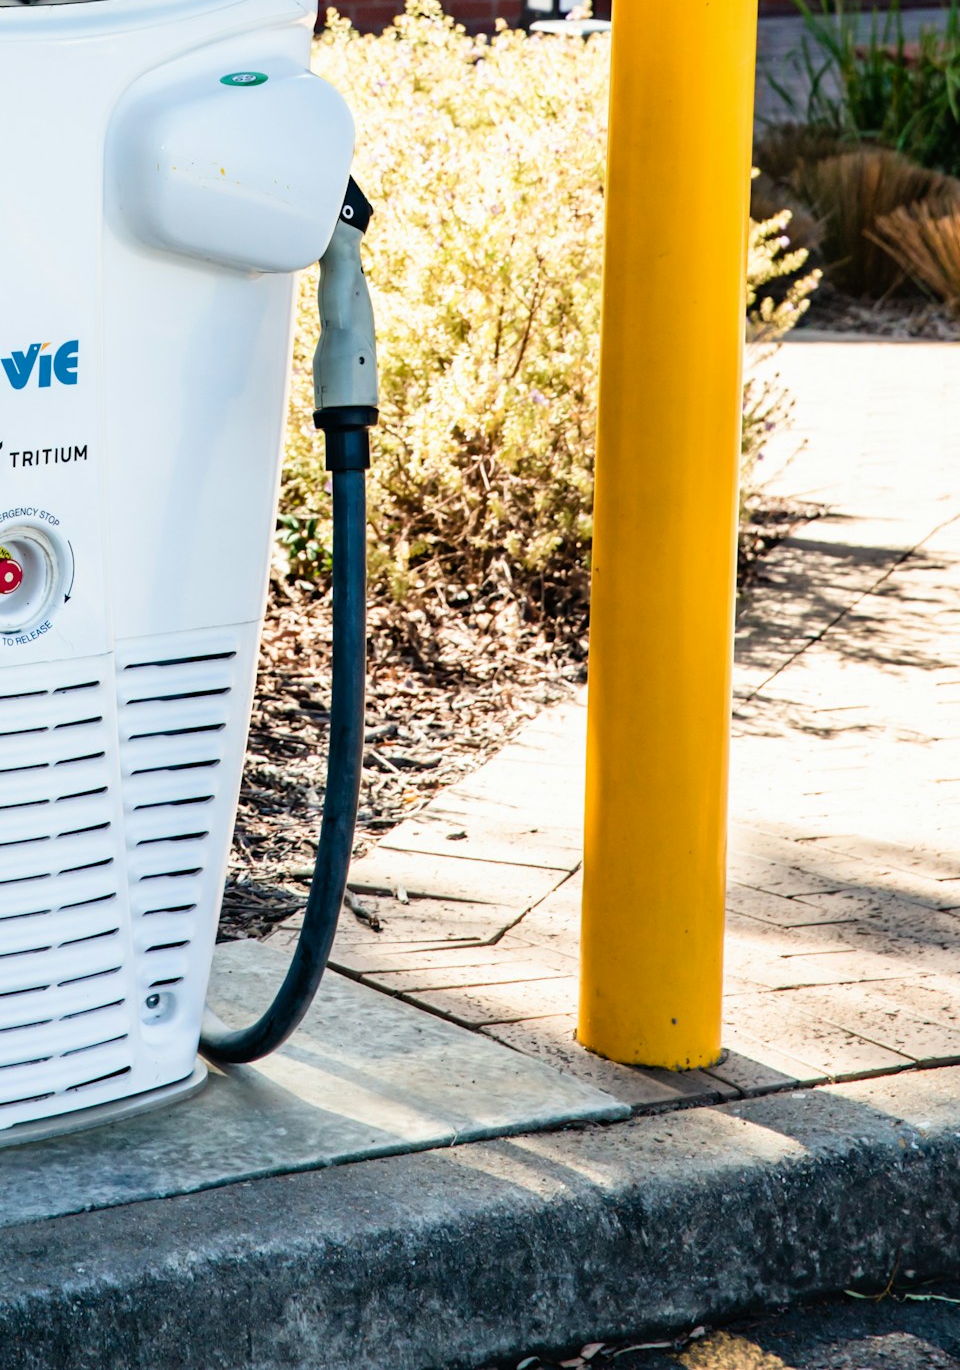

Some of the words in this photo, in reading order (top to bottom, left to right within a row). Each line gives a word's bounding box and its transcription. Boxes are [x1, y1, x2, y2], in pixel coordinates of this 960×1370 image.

[9, 445, 88, 468] TRITIUM
[39, 510, 60, 527] STOP
[2, 637, 14, 647] TO
[15, 620, 53, 646] RELEASE
